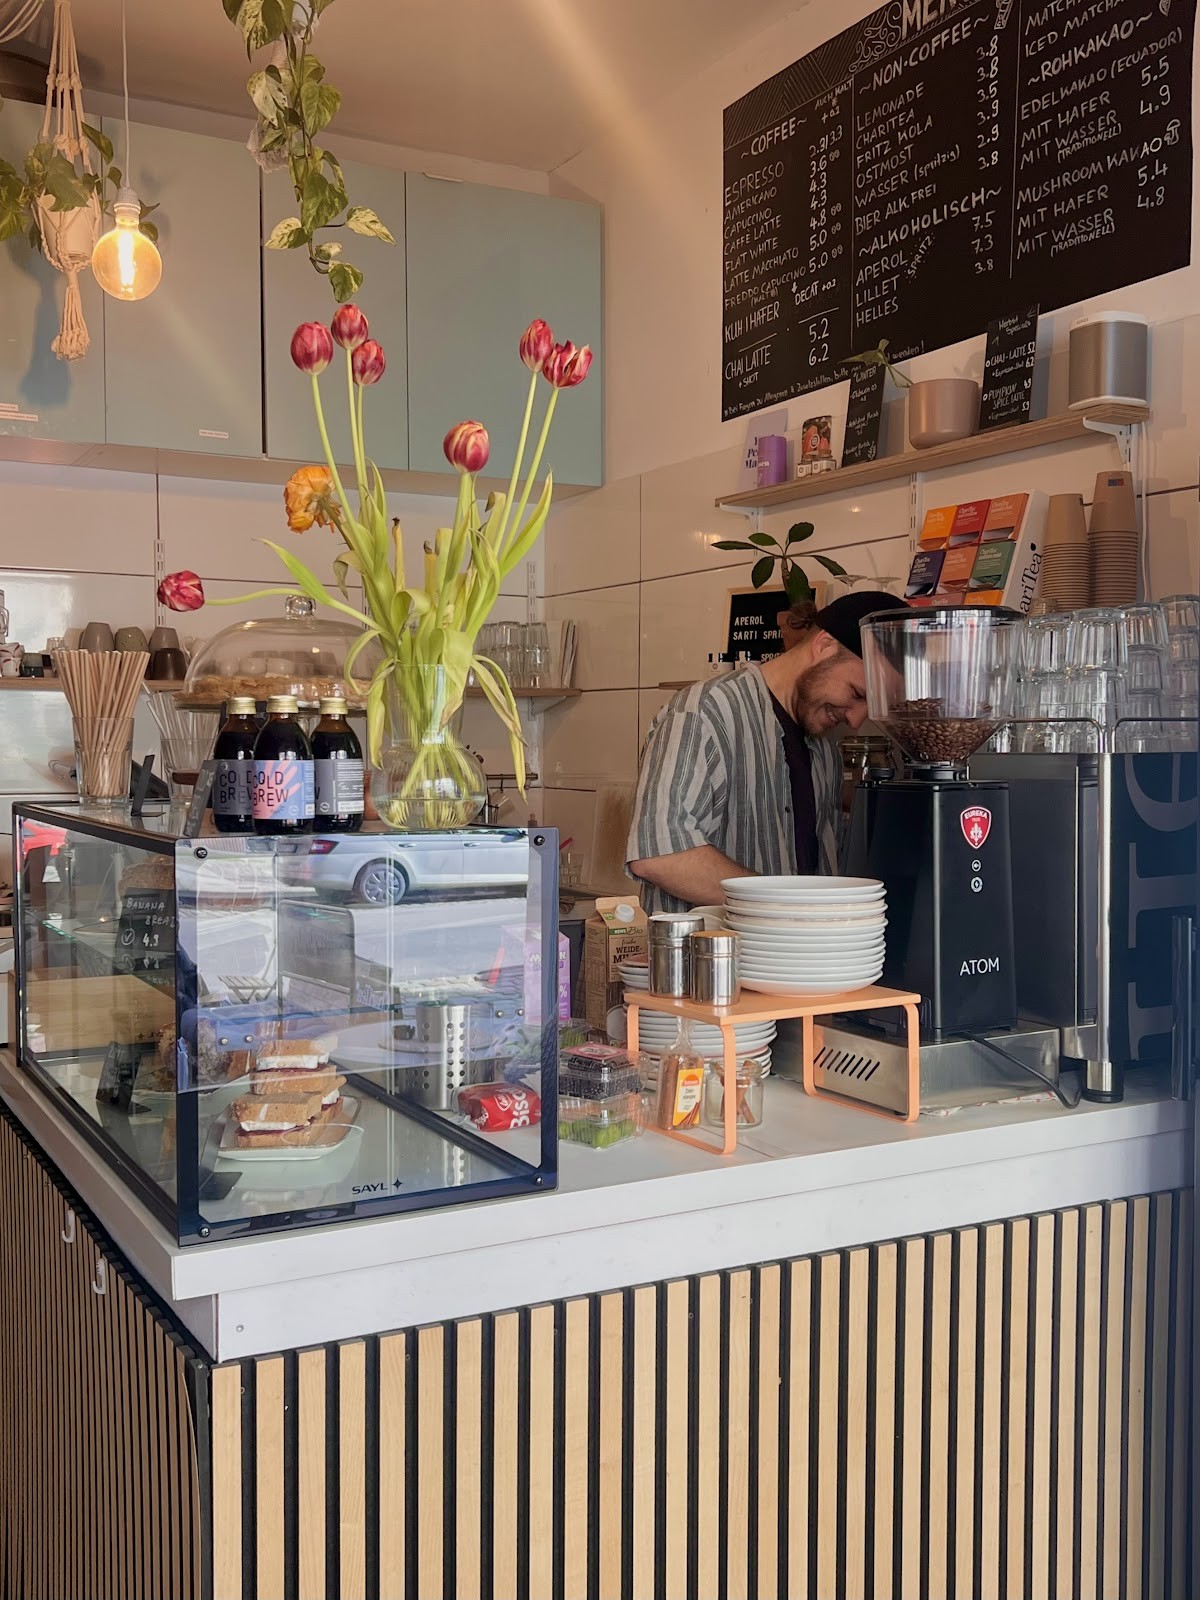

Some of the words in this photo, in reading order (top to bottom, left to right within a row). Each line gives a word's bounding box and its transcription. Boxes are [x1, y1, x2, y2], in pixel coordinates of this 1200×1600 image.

[1021, 68, 1108, 120] EDELKAKAO
[1111, 26, 1183, 79] (ECUADOR)
[1025, 31, 1059, 58] ICED
[1040, 20, 1134, 82] ROHKAKAO
[856, 82, 925, 132] LEMONADE
[976, 35, 999, 60] 3.8
[856, 108, 915, 150] CHARITEA
[977, 56, 999, 82] 3.8
[1021, 119, 1053, 148] MIT
[1057, 91, 1111, 129] HAFER
[1141, 55, 1170, 87] 5.5
[856, 140, 892, 169] FRITZ
[898, 115, 933, 145] KOLA
[977, 80, 999, 102] 3.5
[856, 144, 914, 188] OSTMOST
[977, 99, 999, 126] 3.9
[1020, 141, 1051, 170] MIT
[1055, 109, 1117, 150] WASSER
[1139, 84, 1171, 115] 4.9
[724, 161, 784, 207] ESPRESSO
[724, 186, 777, 224] AMERICANO
[809, 155, 827, 178] 3.6
[855, 170, 909, 208] WASSER
[914, 144, 960, 181] (spritzig)
[977, 124, 1000, 148] 2.9
[855, 210, 880, 235] BIER
[911, 183, 937, 204] FREI
[978, 151, 999, 170] 3.8
[1017, 161, 1104, 210] MUSHROOM
[1017, 207, 1048, 236] MIT
[1053, 185, 1109, 217] HAFER
[1137, 159, 1168, 187] 5.4
[724, 208, 772, 239] CAPUCCINO
[809, 172, 827, 192] 4.3
[754, 215, 781, 240] LATTE
[810, 189, 827, 210] 4.3
[870, 187, 985, 255] ALKOHOLISCH
[1017, 231, 1048, 260] MIT
[1051, 208, 1114, 243] WASSER
[1137, 186, 1165, 210] 4.8
[724, 270, 750, 293] LATTE
[752, 247, 799, 279] MACCHIATO
[809, 229, 828, 251] 5.0
[725, 252, 748, 274] FLAT
[750, 237, 778, 259] WHITE
[810, 208, 827, 230] 4.8
[856, 250, 908, 287] APEROL
[971, 210, 996, 232] 7.5
[856, 274, 900, 308] LILLET
[971, 234, 994, 254] 7.3
[907, 235, 933, 277] SPRITZ
[725, 287, 760, 310] FREDDO
[761, 266, 806, 294] CAPUCCINO
[808, 252, 829, 273] 5.0
[856, 296, 899, 328] HELLES
[974, 259, 994, 274] 3.8
[725, 320, 743, 343] KUH
[750, 301, 780, 330] HAFER
[725, 359, 744, 380] CHAI
[746, 345, 772, 372] LATTE
[808, 318, 830, 343] 5.2
[808, 343, 830, 366] 6.2
[1019, 553, 1043, 613] ariTea
[732, 630, 757, 641] SARTI
[734, 615, 764, 626] APEROL
[253, 771, 284, 789] COLD
[253, 789, 289, 807] BREW
[126, 897, 165, 912] BANANA
[960, 957, 999, 976] ATOM
[352, 1182, 389, 1195] SAYL
